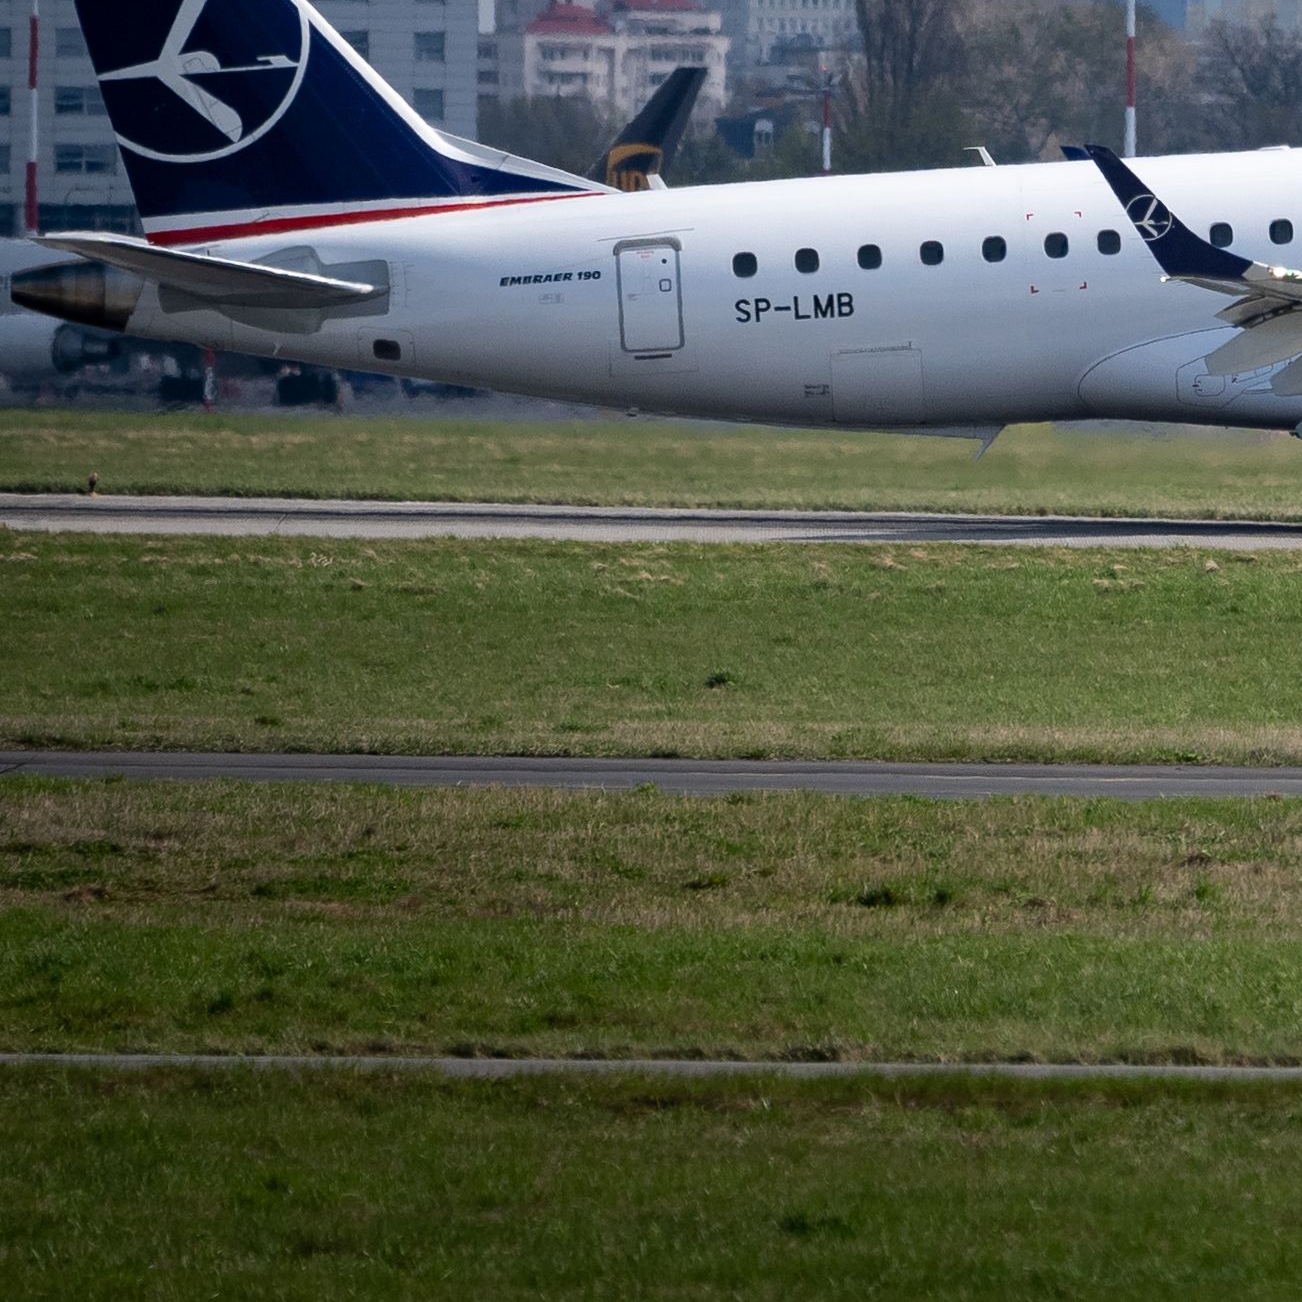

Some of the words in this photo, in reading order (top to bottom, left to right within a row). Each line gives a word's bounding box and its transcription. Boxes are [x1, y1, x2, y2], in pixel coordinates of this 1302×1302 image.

[499, 272, 573, 287] EMBRAER
[577, 270, 601, 281] 190
[735, 292, 855, 323] SP-LMB
